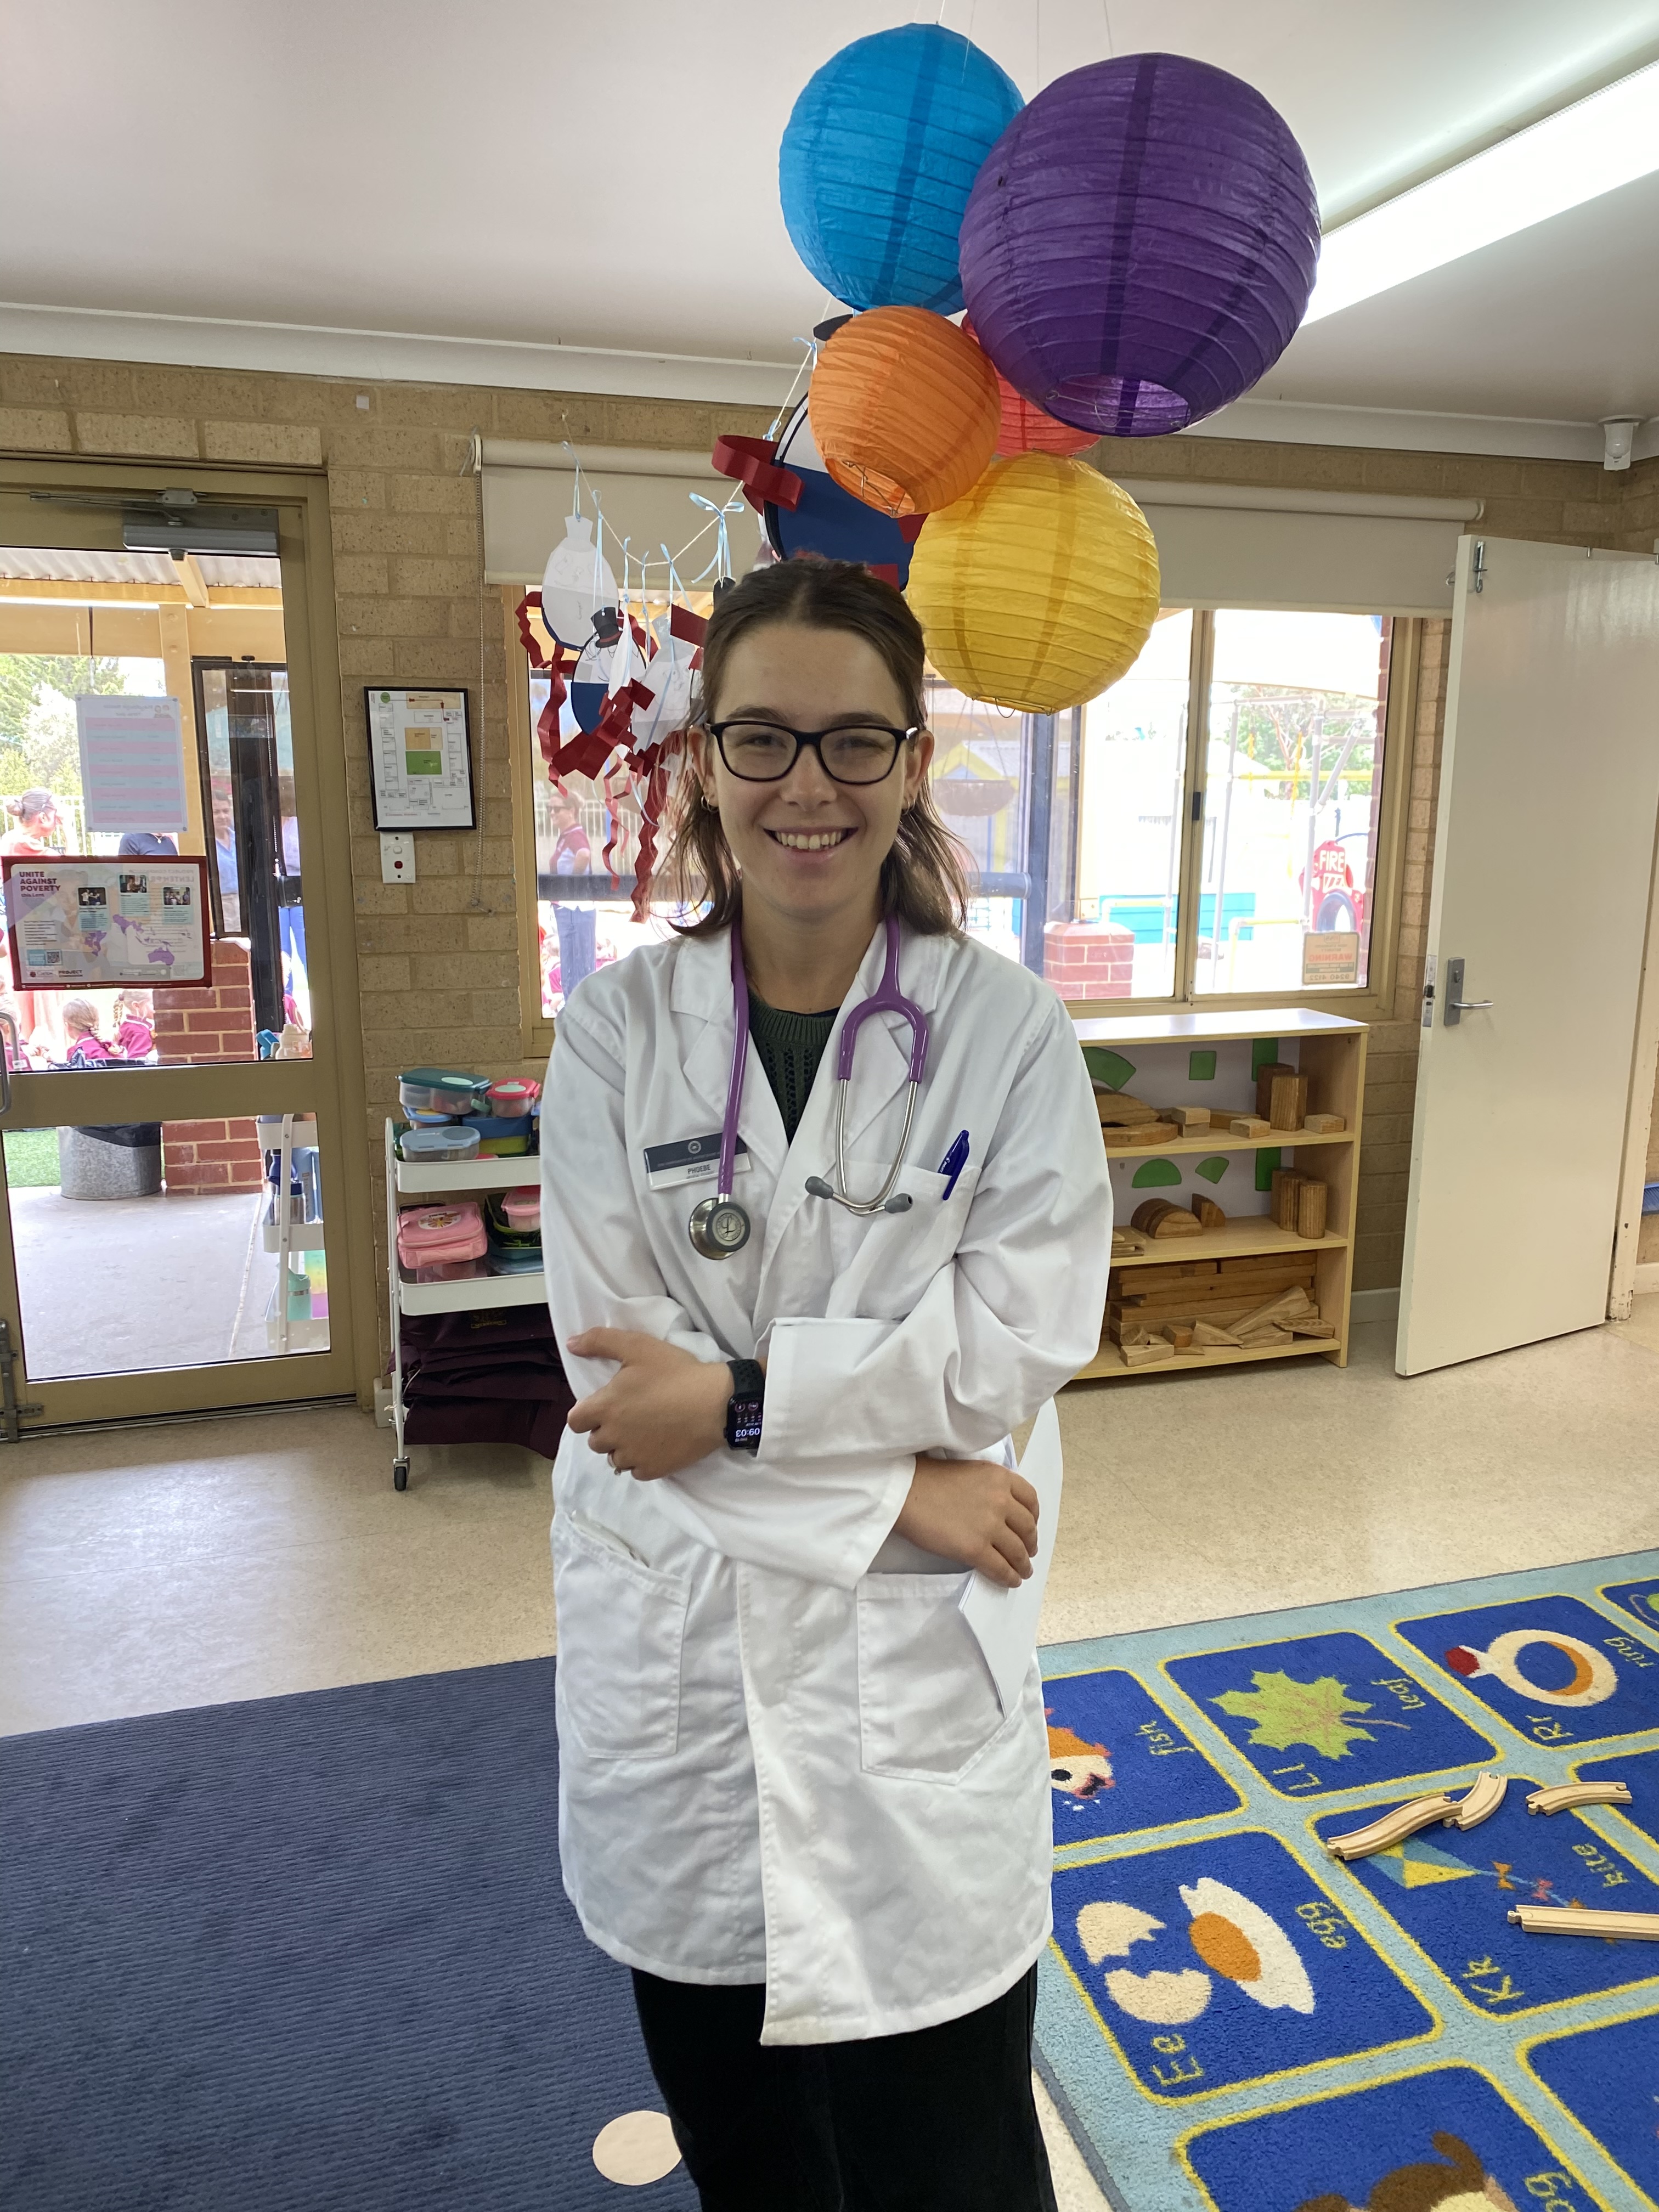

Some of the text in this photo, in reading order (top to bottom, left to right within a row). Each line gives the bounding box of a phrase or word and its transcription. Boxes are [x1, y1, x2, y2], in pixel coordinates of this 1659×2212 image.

[1319, 850, 1345, 873] FIRE
[687, 1164, 710, 1174] PHOEBE
[1603, 1637, 1655, 1668] ring
[1372, 1678, 1426, 1710] leaf
[1135, 1719, 1196, 1756] fish
[1525, 1715, 1574, 1740] Rr
[1572, 1843, 1630, 1888] kite
[1295, 1901, 1349, 1949] egg
[1462, 1954, 1525, 2004] Kk
[1151, 2033, 1205, 2087] Ee
[1525, 2171, 1577, 2212] og
